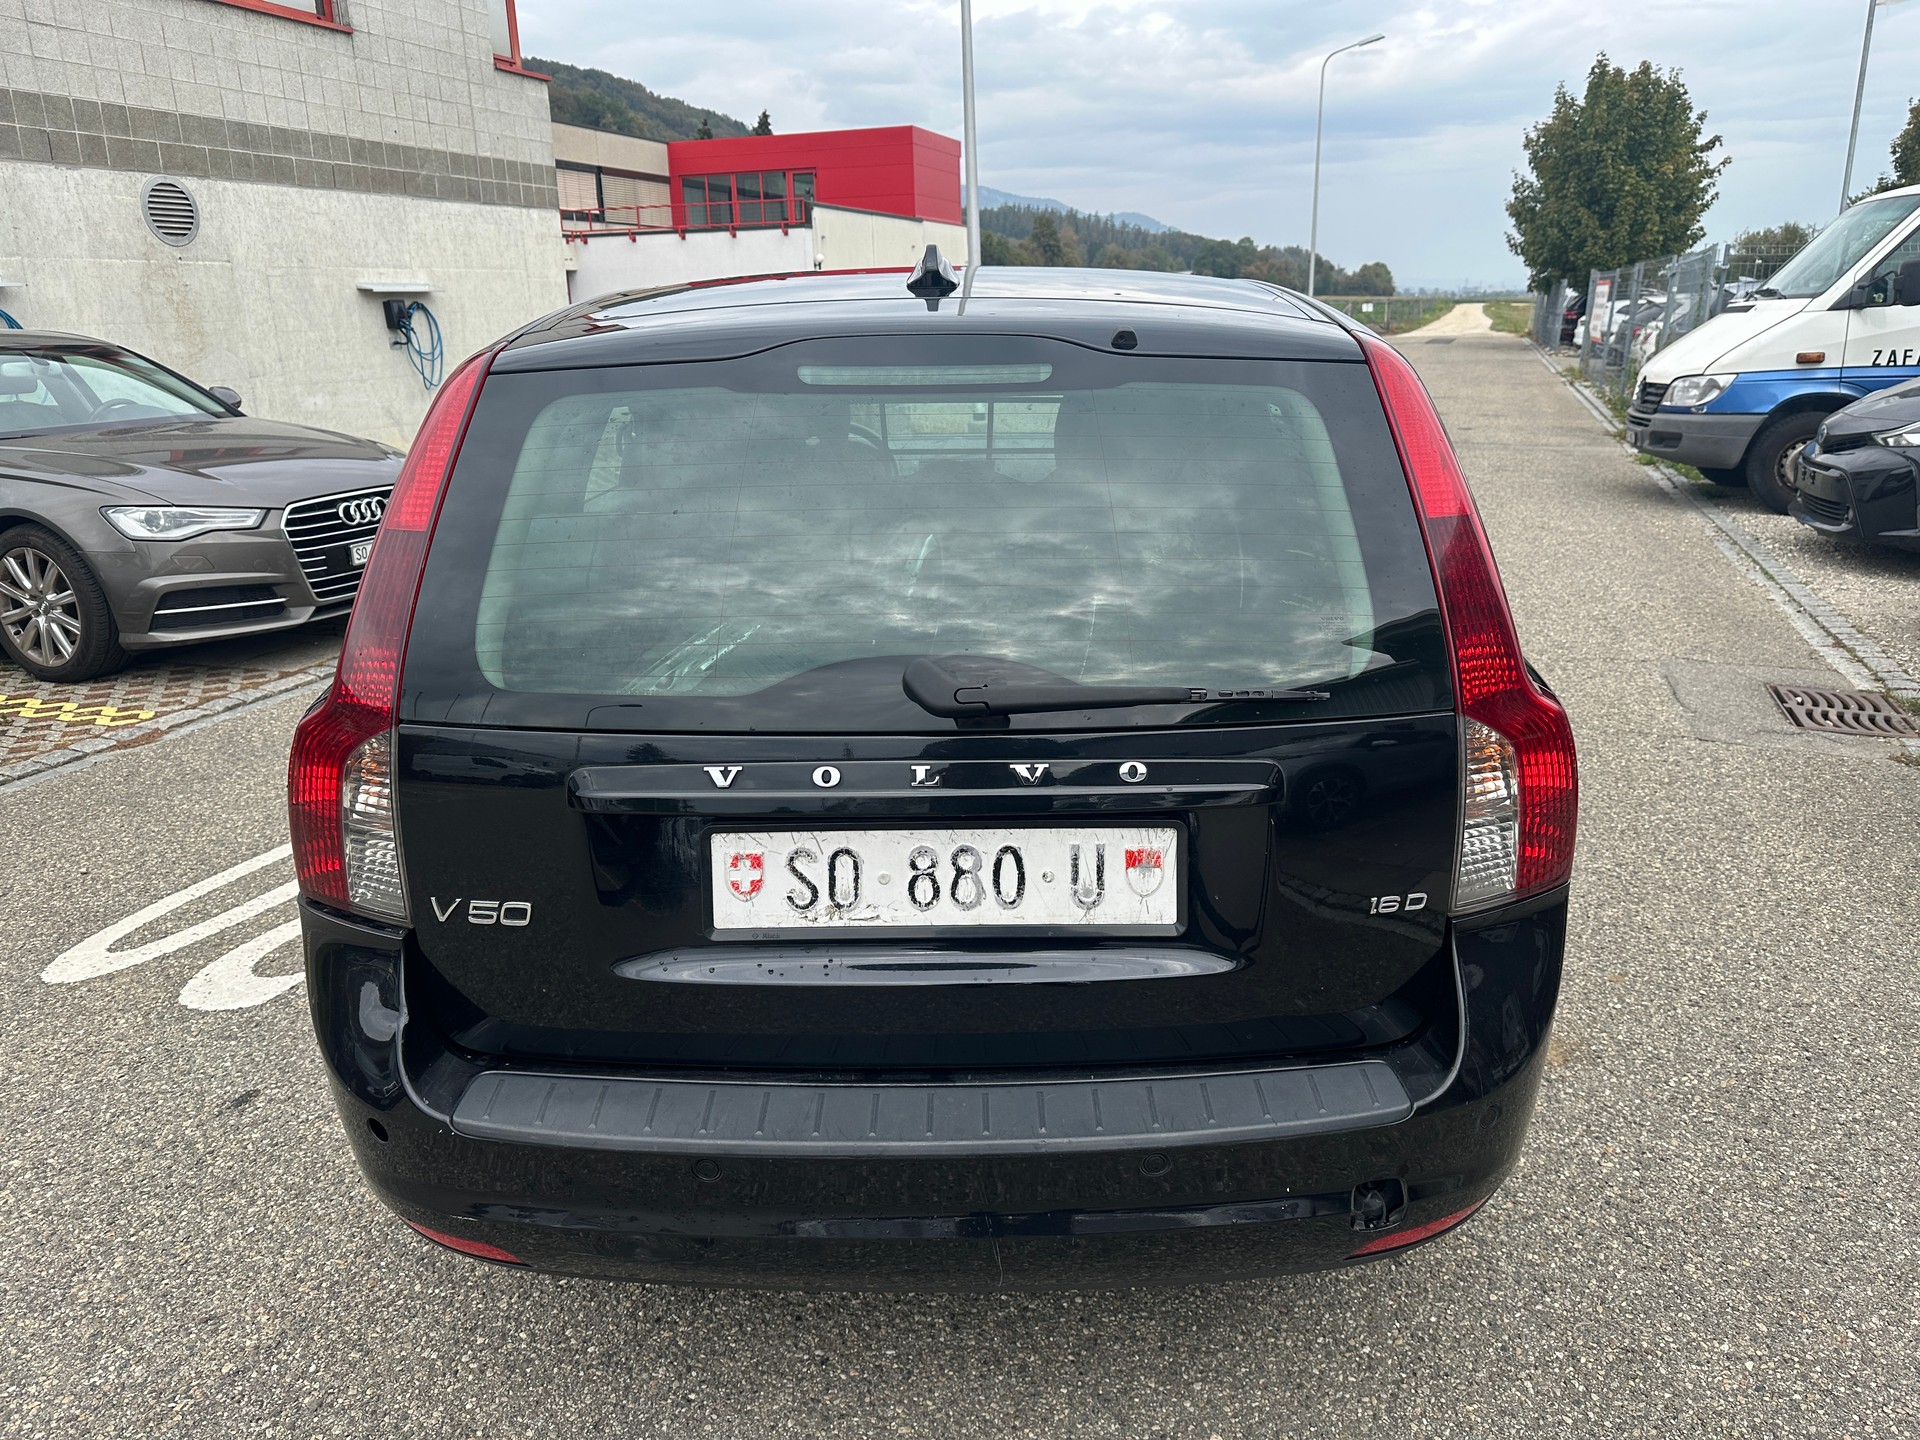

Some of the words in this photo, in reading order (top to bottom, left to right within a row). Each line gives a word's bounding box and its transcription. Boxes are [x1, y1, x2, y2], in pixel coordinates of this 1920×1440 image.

[355, 546, 368, 561] SO
[703, 761, 1148, 788] VOLVO
[784, 846, 862, 912] SO
[907, 844, 1027, 911] 880
[1069, 843, 1106, 909] U
